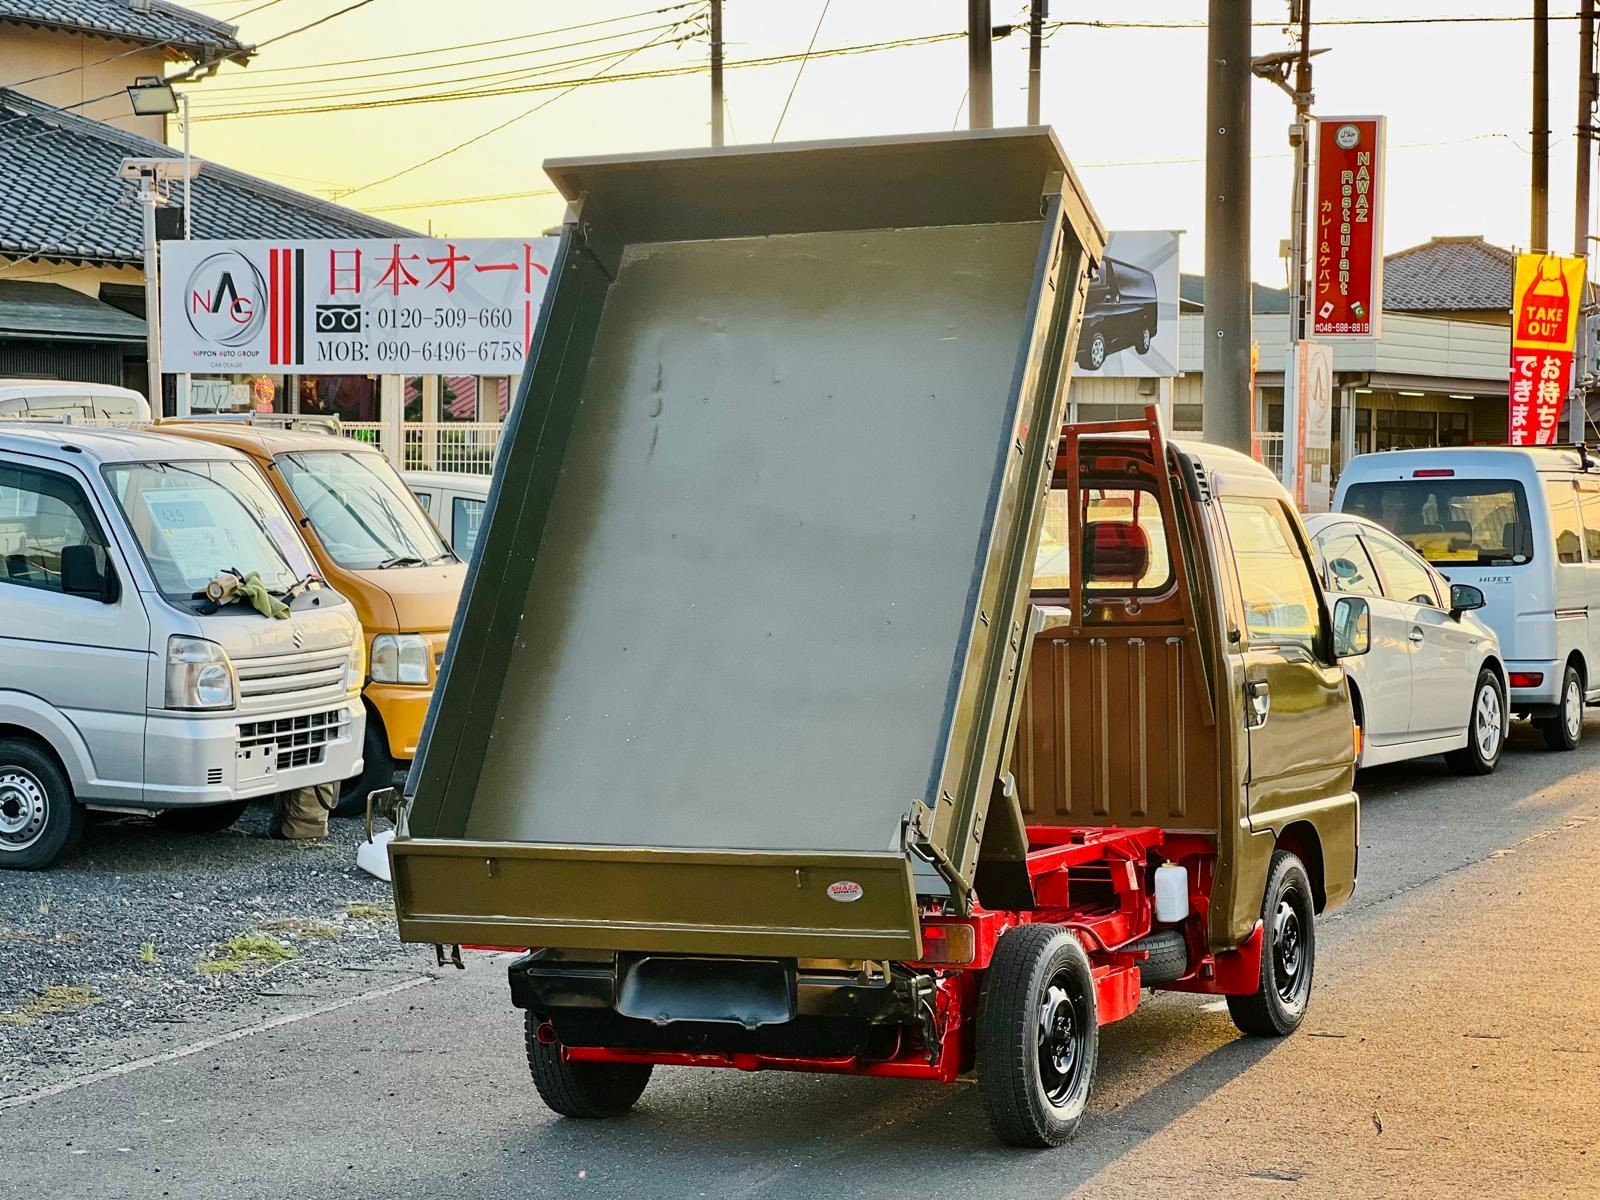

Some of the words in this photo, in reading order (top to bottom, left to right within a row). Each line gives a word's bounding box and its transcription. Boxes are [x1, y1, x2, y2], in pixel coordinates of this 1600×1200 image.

[1355, 151, 1371, 223] NAWAZ
[1339, 170, 1354, 296] Restaurant
[328, 243, 549, 296] 日本オート
[377, 307, 512, 329] 0120-509-660
[1526, 306, 1563, 322] TAKE
[1528, 322, 1558, 337] OUT
[316, 340, 369, 362] MOB:
[376, 341, 523, 362] 090-6496-6758
[1479, 575, 1512, 583] HIJET
[831, 884, 859, 892] SHAZA
